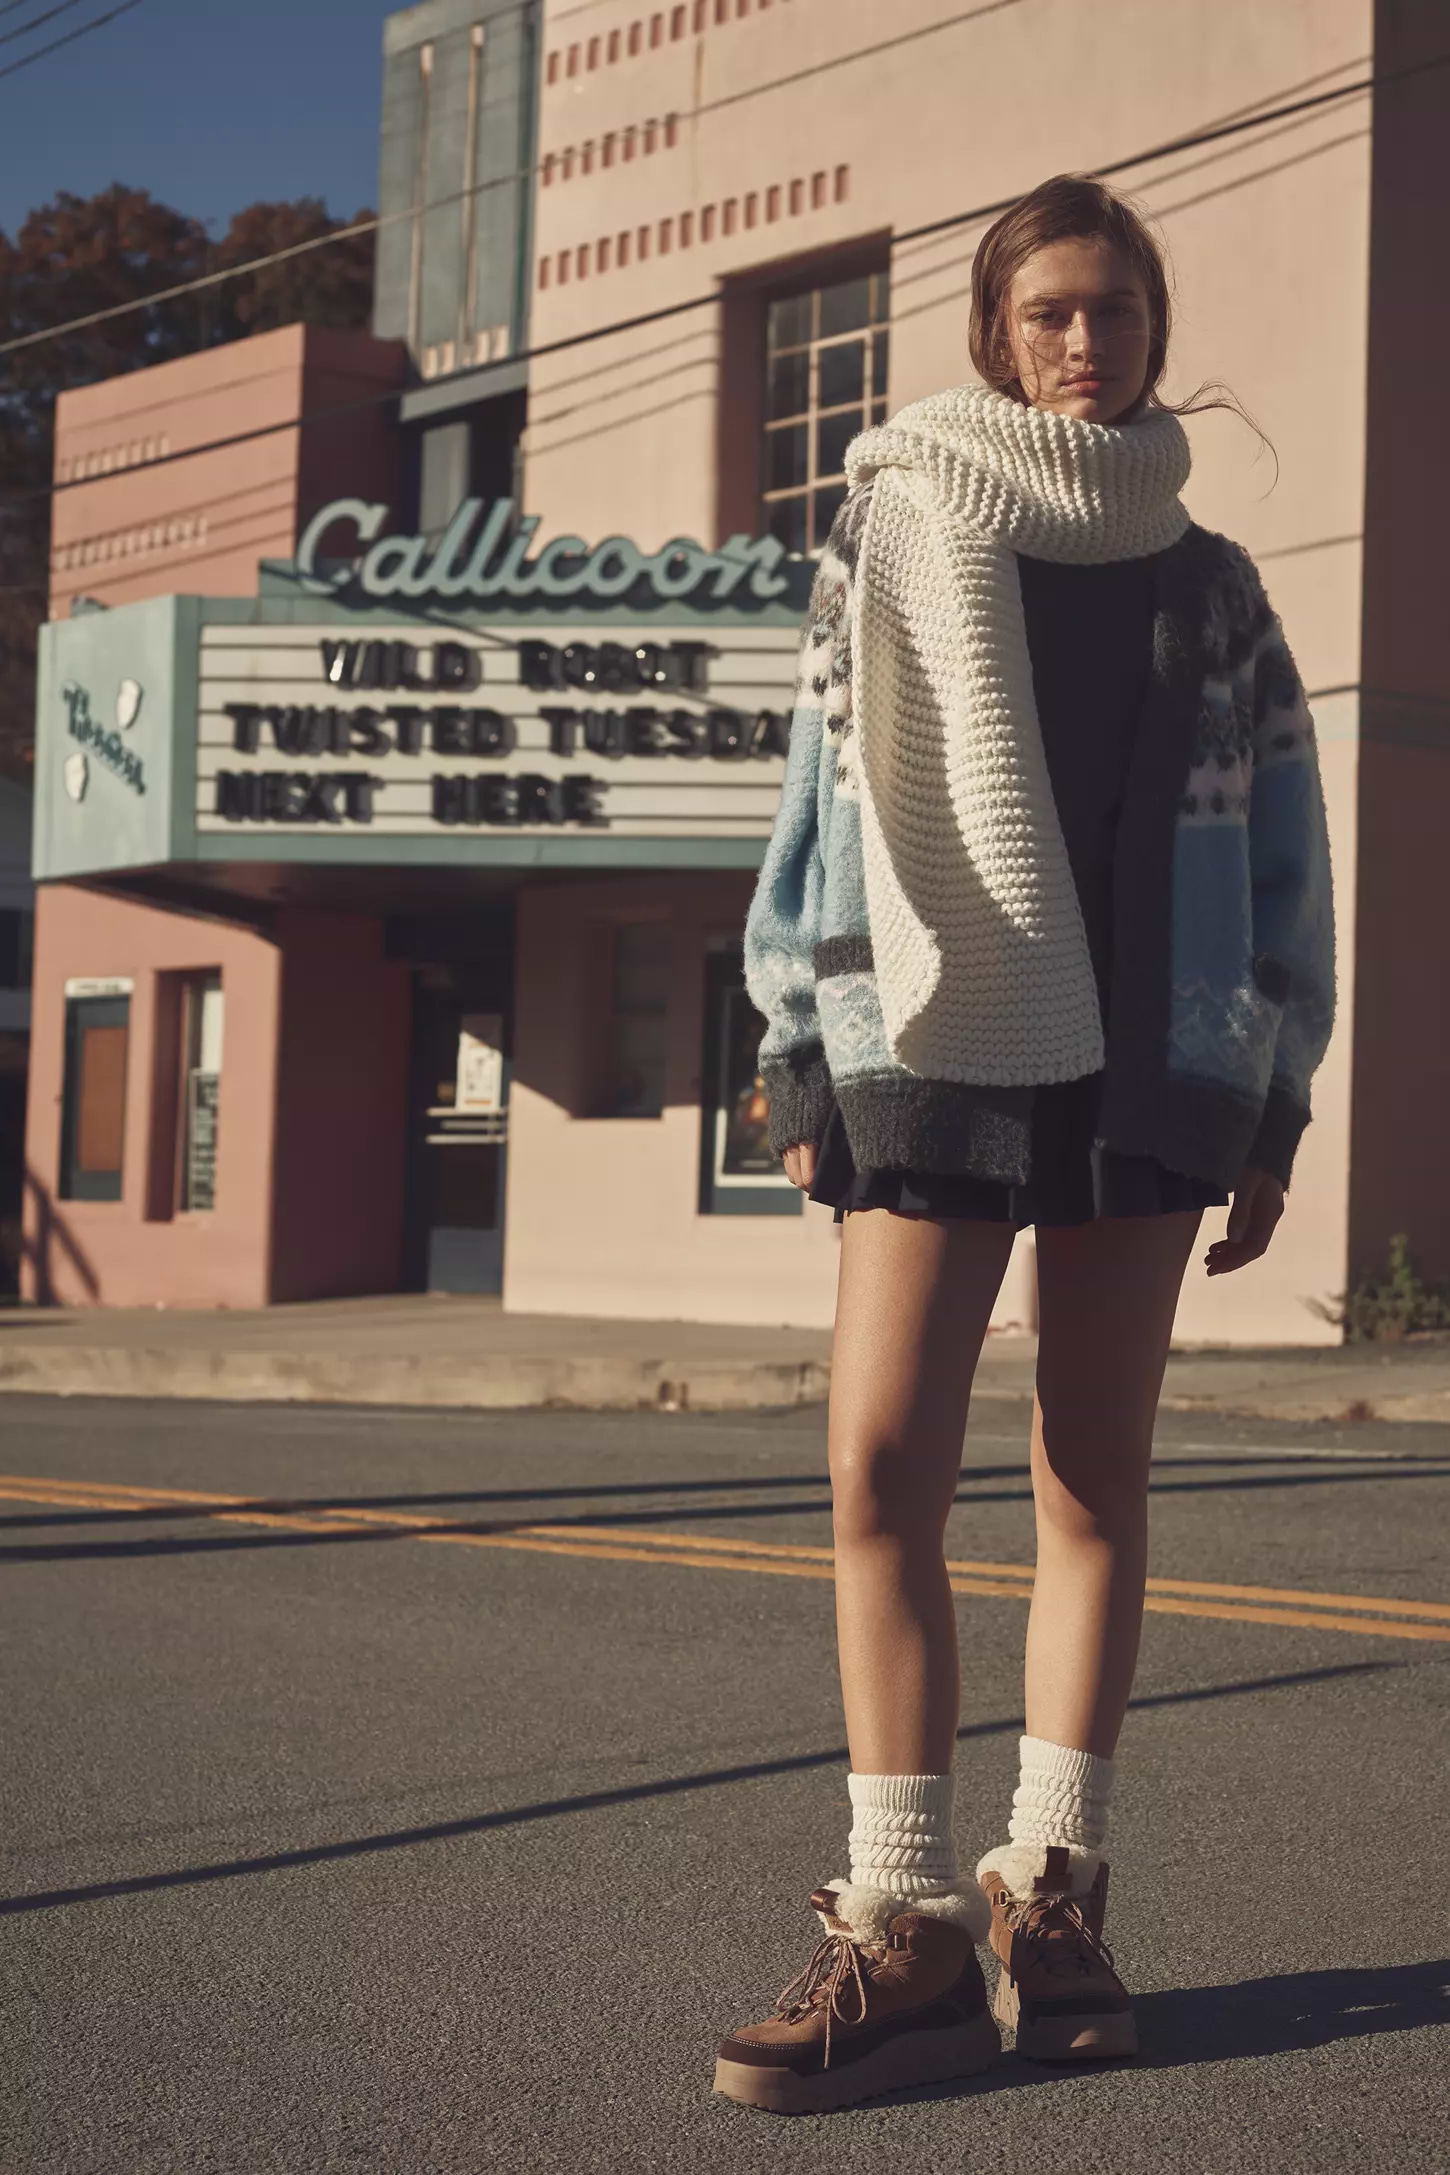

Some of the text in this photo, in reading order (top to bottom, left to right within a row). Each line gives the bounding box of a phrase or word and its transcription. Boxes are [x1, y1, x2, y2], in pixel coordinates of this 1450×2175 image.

[297, 498, 788, 596] Callicoon
[320, 638, 720, 693] WILD ROBOT
[223, 703, 794, 761] TWISTED TUESDA
[217, 769, 610, 827] NEXT HERE
